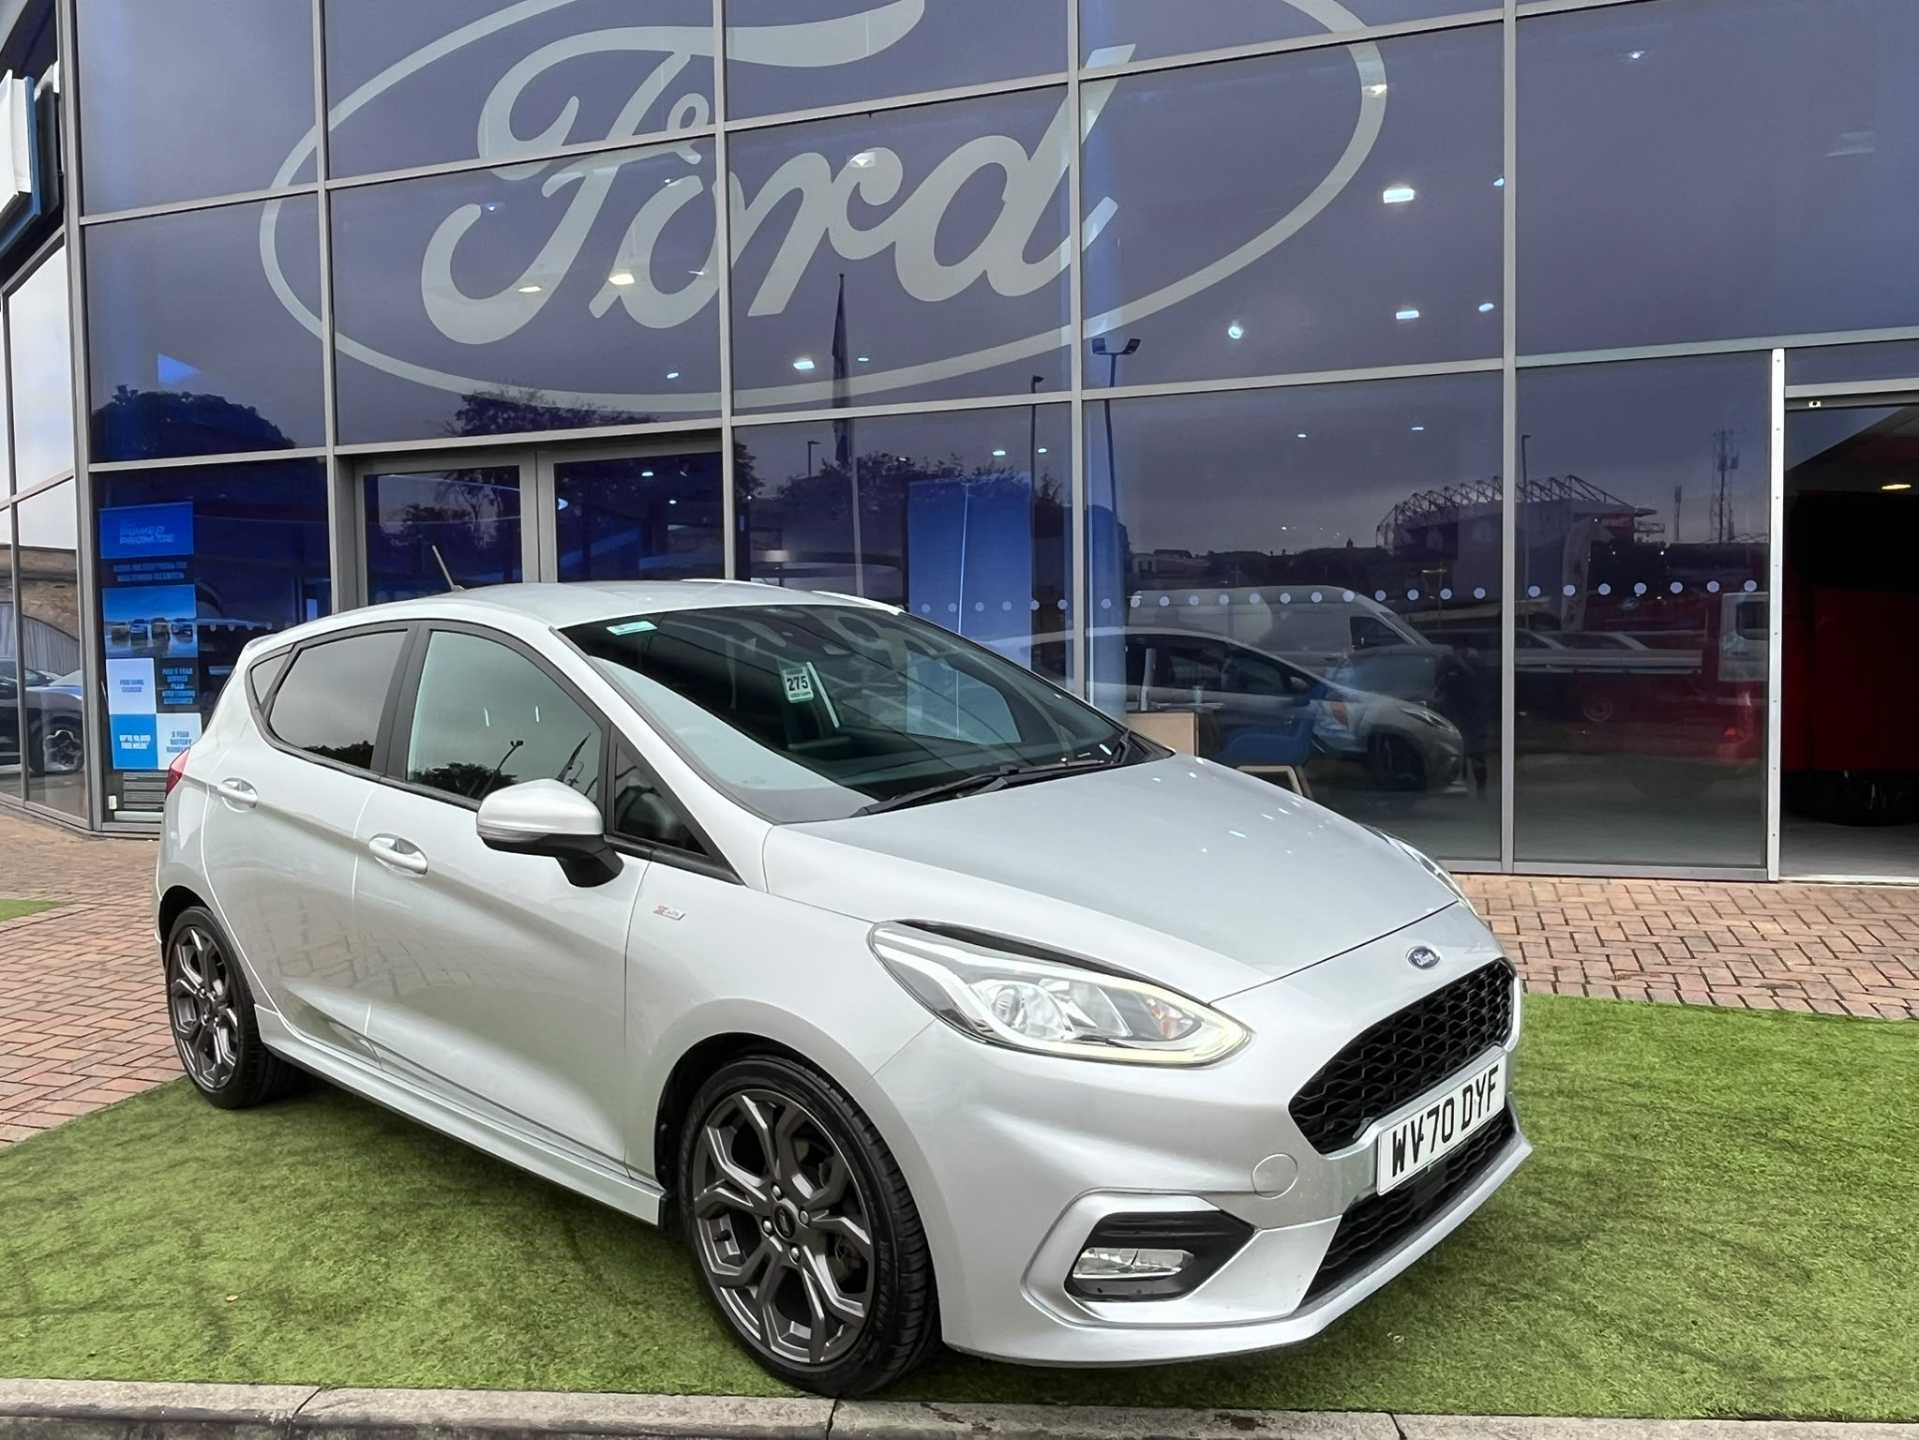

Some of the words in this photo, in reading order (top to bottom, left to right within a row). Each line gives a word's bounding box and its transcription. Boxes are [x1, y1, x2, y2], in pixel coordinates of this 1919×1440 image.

[421, 0, 1136, 345] Ford
[786, 675, 809, 692] 275
[1392, 1097, 1455, 1177] WV70
[1461, 1064, 1499, 1132] DYF
